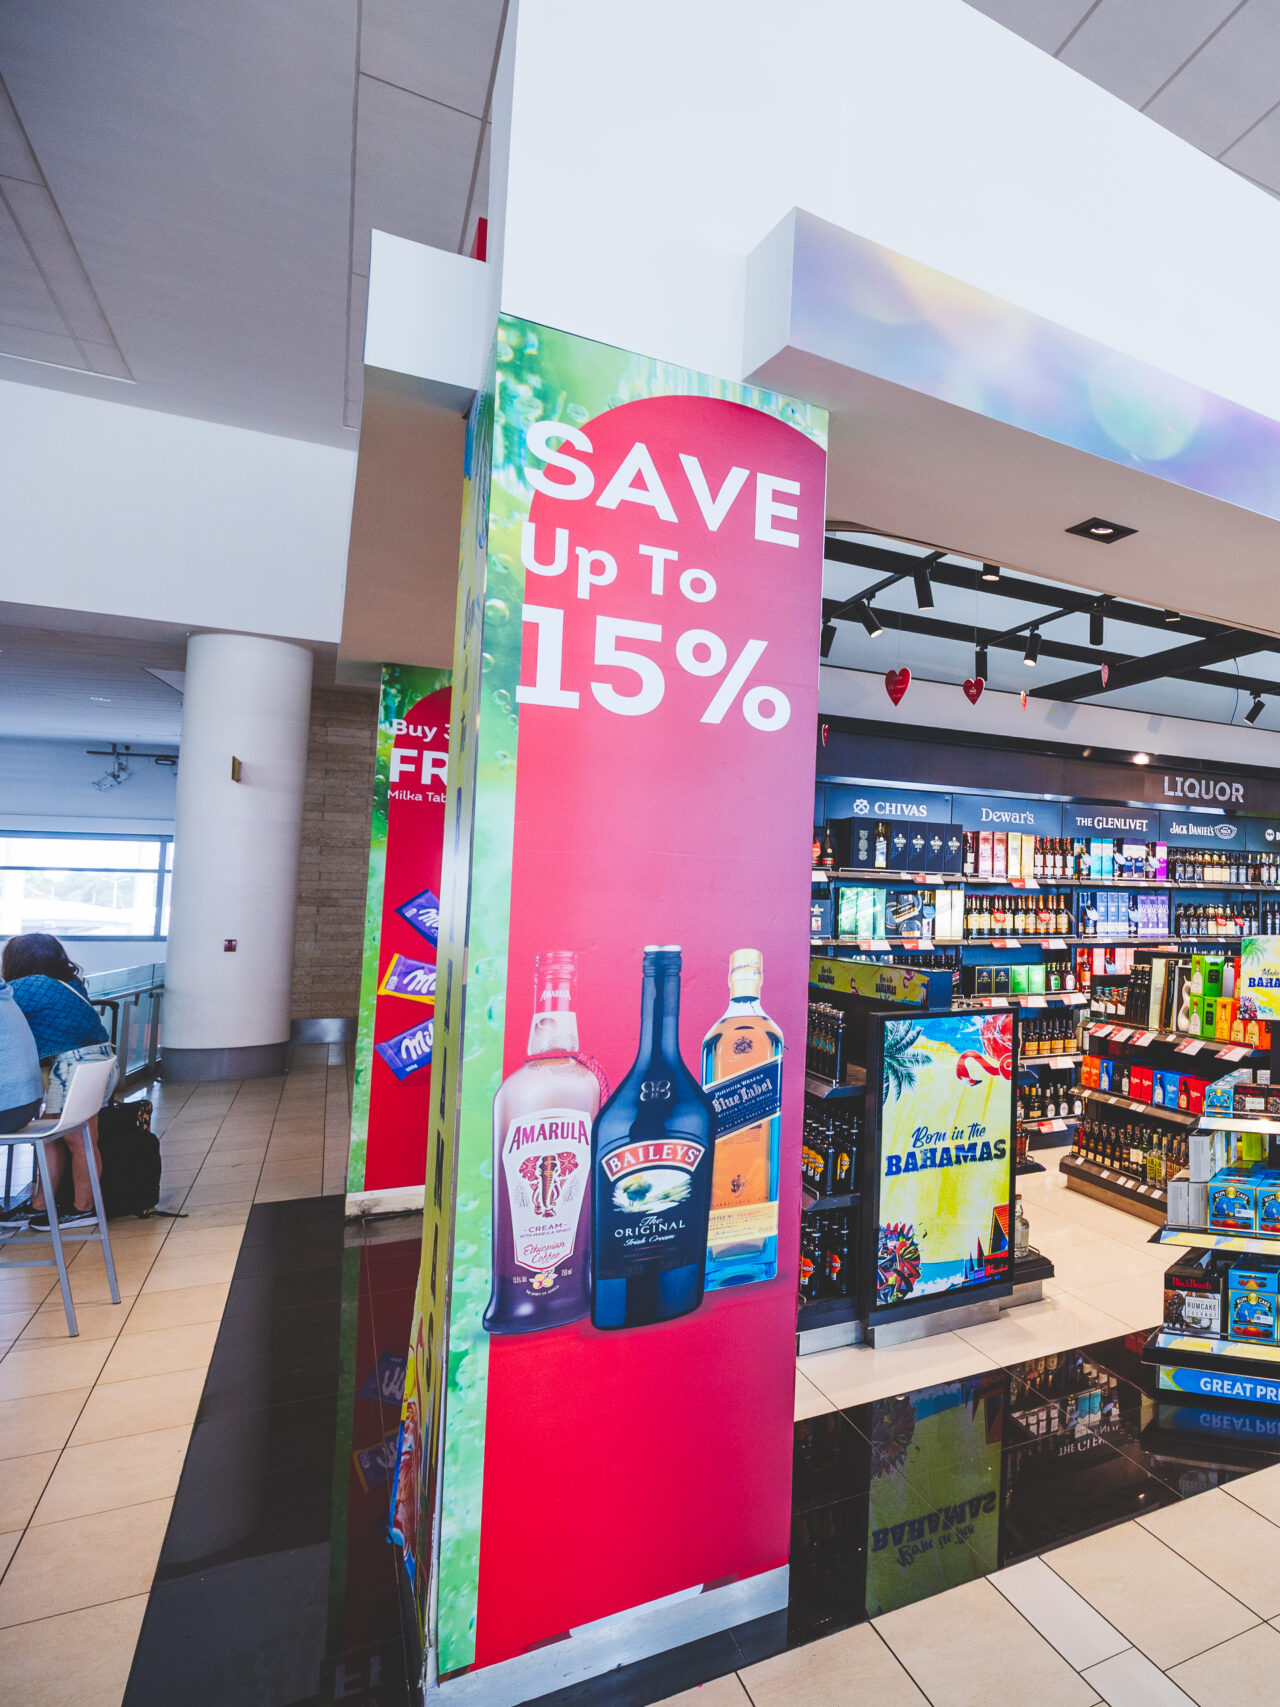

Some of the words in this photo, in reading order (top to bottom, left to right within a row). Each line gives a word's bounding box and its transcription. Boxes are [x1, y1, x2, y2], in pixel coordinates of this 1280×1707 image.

[524, 420, 801, 549] SAVE
[521, 521, 618, 599] Up
[638, 544, 717, 603] To
[516, 603, 791, 732] 15%
[392, 718, 438, 743] Buy
[387, 789, 423, 802] Milka
[1163, 776, 1244, 803] LIQUOR
[874, 801, 928, 817] CHIVAS
[981, 808, 1035, 825] Dewar's
[1076, 816, 1093, 828] THE
[1094, 816, 1149, 832] GLENLIVET
[1170, 822, 1188, 835] JACK
[1188, 823, 1215, 836] DANIEL'S
[1262, 968, 1280, 977] Made
[741, 1074, 764, 1086] WALKER
[712, 1094, 740, 1113] Blue
[738, 1078, 773, 1102] Label
[508, 1120, 590, 1154] AMARULA
[911, 1125, 947, 1149] Born
[951, 1127, 964, 1142] in
[967, 1121, 986, 1140] the
[609, 1145, 698, 1173] BAILEYS
[885, 1139, 1007, 1177] BAHAMAS
[1214, 1190, 1225, 1198] RUM
[1236, 1191, 1249, 1200] CAKE
[1264, 1194, 1276, 1202] RUM
[528, 1222, 563, 1233] CREAM
[615, 1220, 686, 1238] ORIGINAL
[639, 1216, 663, 1226] The
[623, 1237, 646, 1246] Irish
[649, 1234, 675, 1243] Cream
[523, 1241, 566, 1256] Ethiopian
[531, 1251, 561, 1264] Coffee
[1187, 1301, 1217, 1310] RUMCAKE
[1236, 1294, 1248, 1304] RUM
[1258, 1297, 1271, 1307] CAKE
[1187, 1310, 1217, 1318] COCONUT
[1200, 1377, 1253, 1397] GREAT
